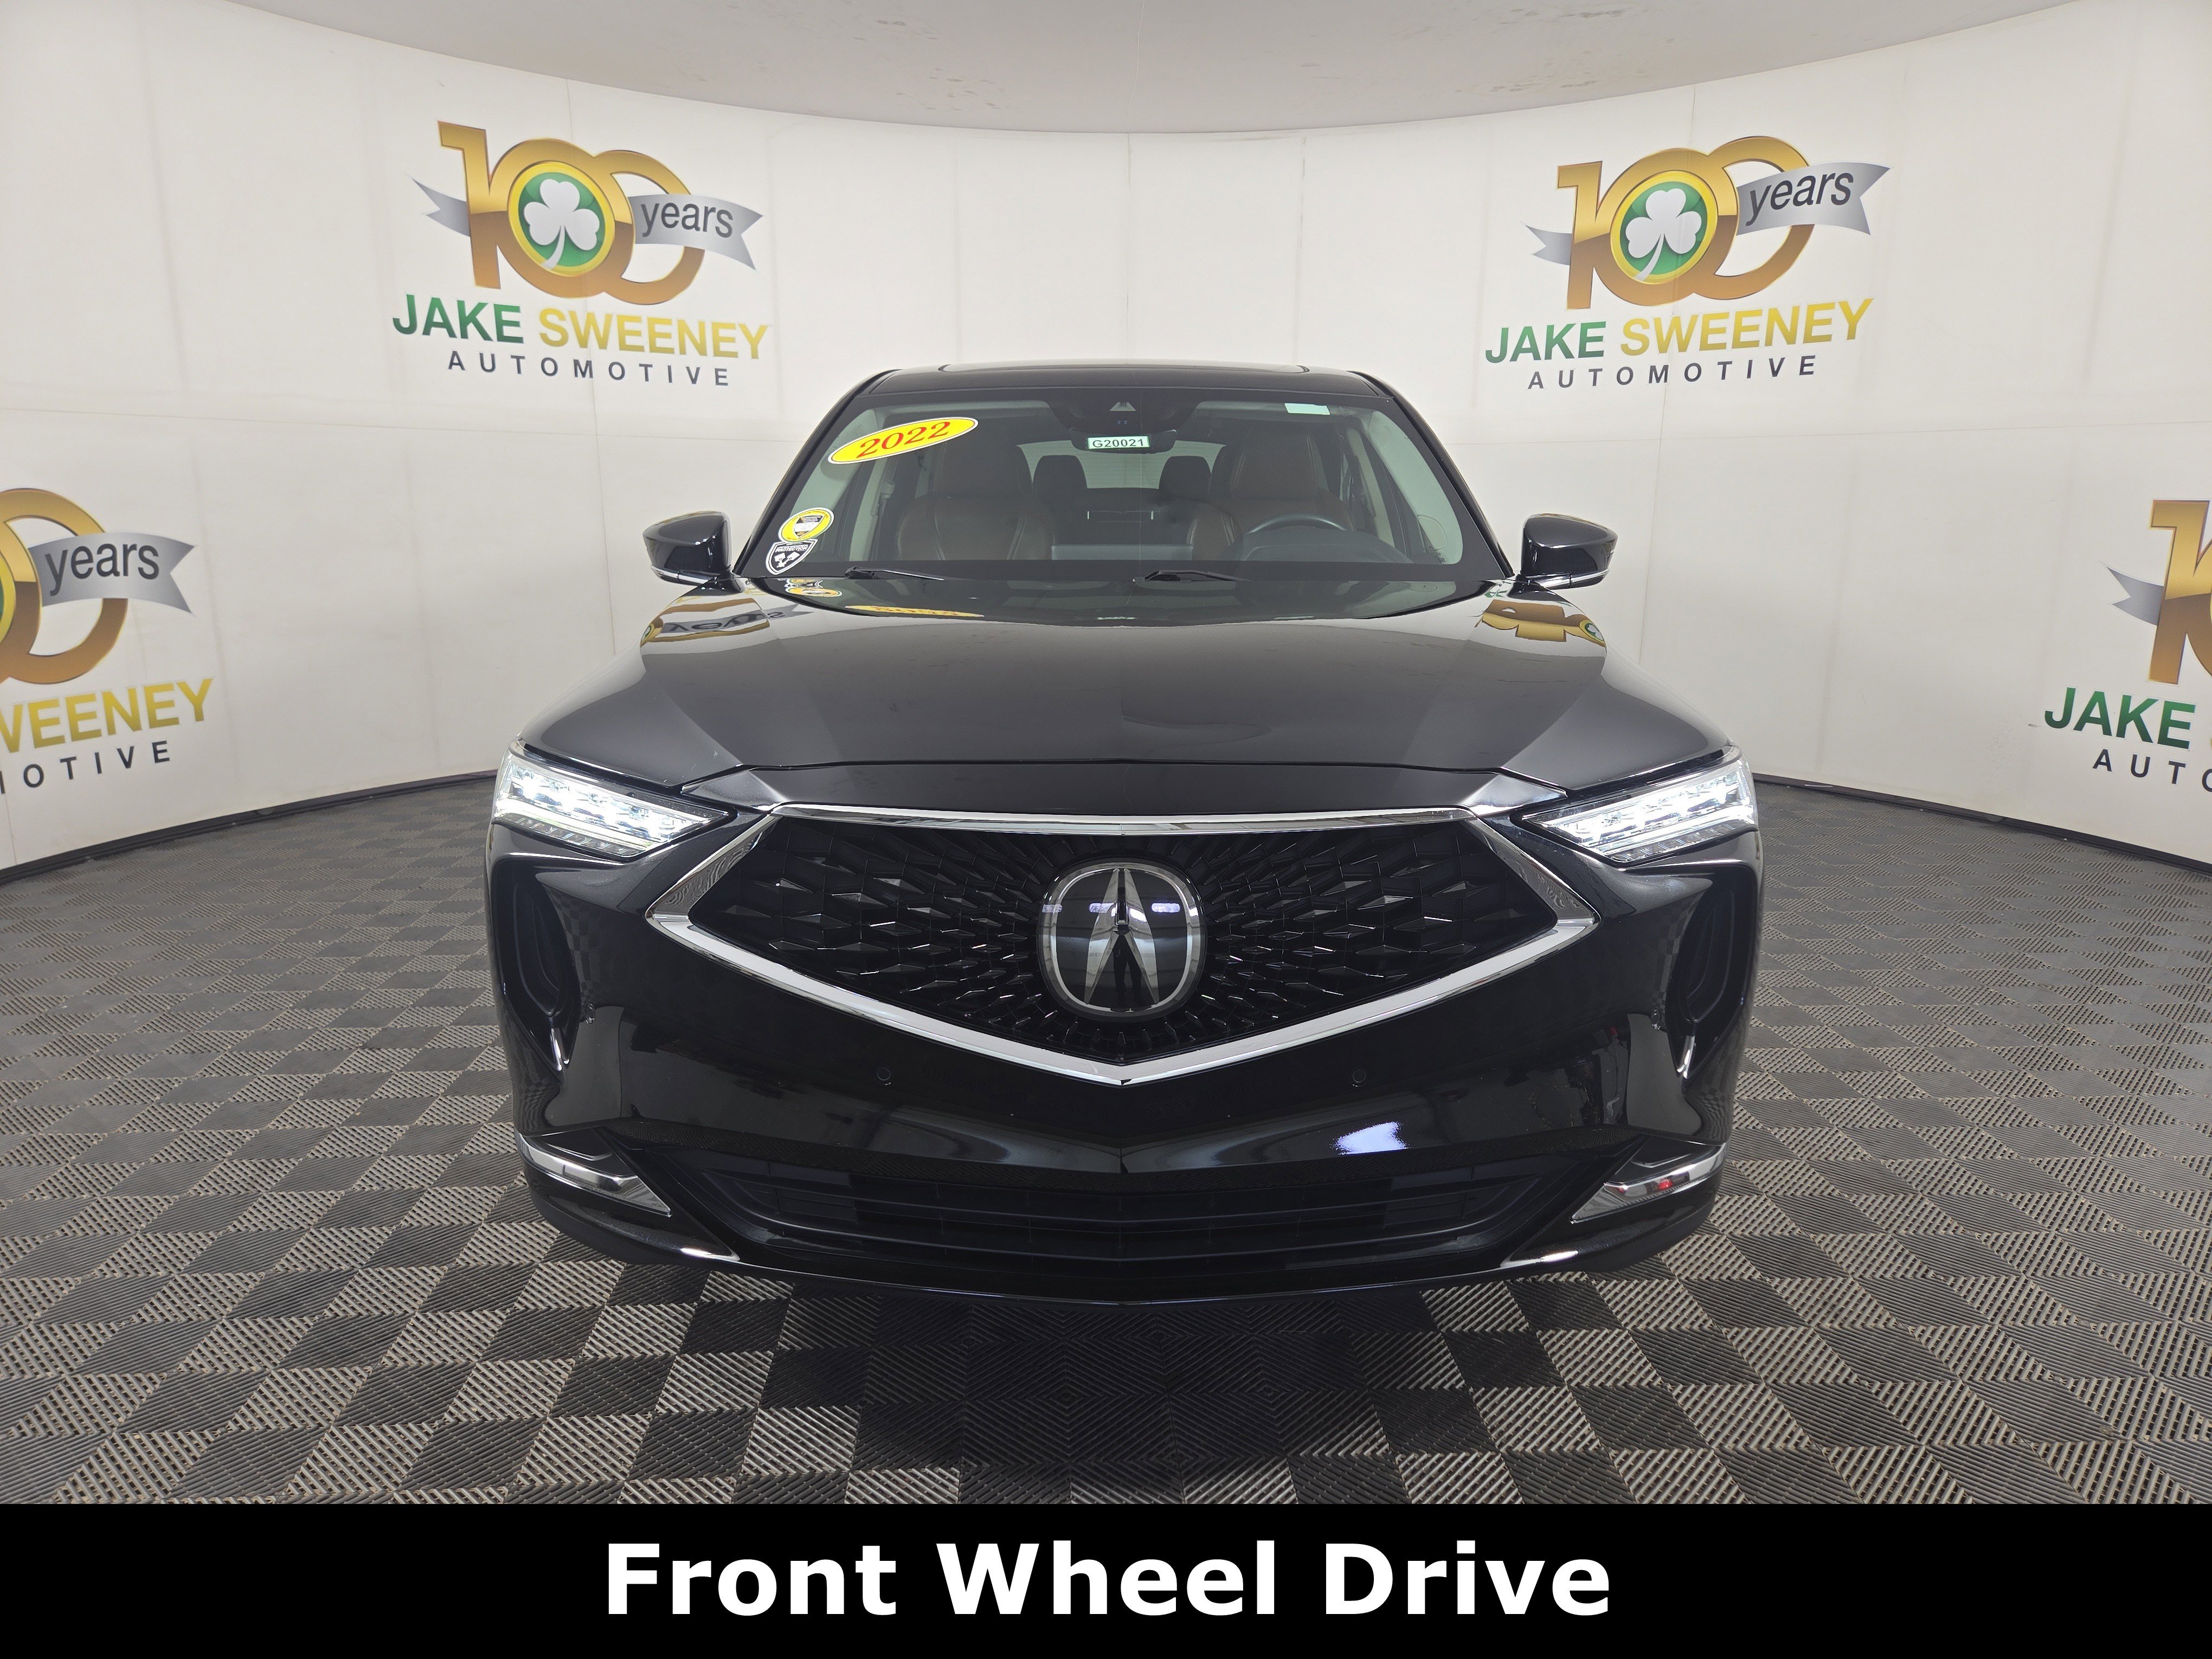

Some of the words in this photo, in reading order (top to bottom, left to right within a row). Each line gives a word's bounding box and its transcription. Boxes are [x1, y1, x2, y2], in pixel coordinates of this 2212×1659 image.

[437, 120, 705, 306] 100
[640, 201, 734, 238] years
[1556, 135, 1815, 311] 100
[1745, 171, 1854, 226] years
[393, 293, 525, 344] JAKE
[539, 308, 769, 360] SWEENEY
[1485, 320, 1607, 364] JAKE
[1619, 297, 1875, 357] SWEENEY
[448, 350, 729, 386] AUTOMOTIVE
[1527, 355, 1817, 390] AUTOMOTIVE
[856, 421, 951, 458] 2022
[1092, 439, 1143, 448] G20021
[44, 543, 160, 596] years
[2044, 687, 2196, 750] JAKE
[0, 740, 170, 794] OTIVE
